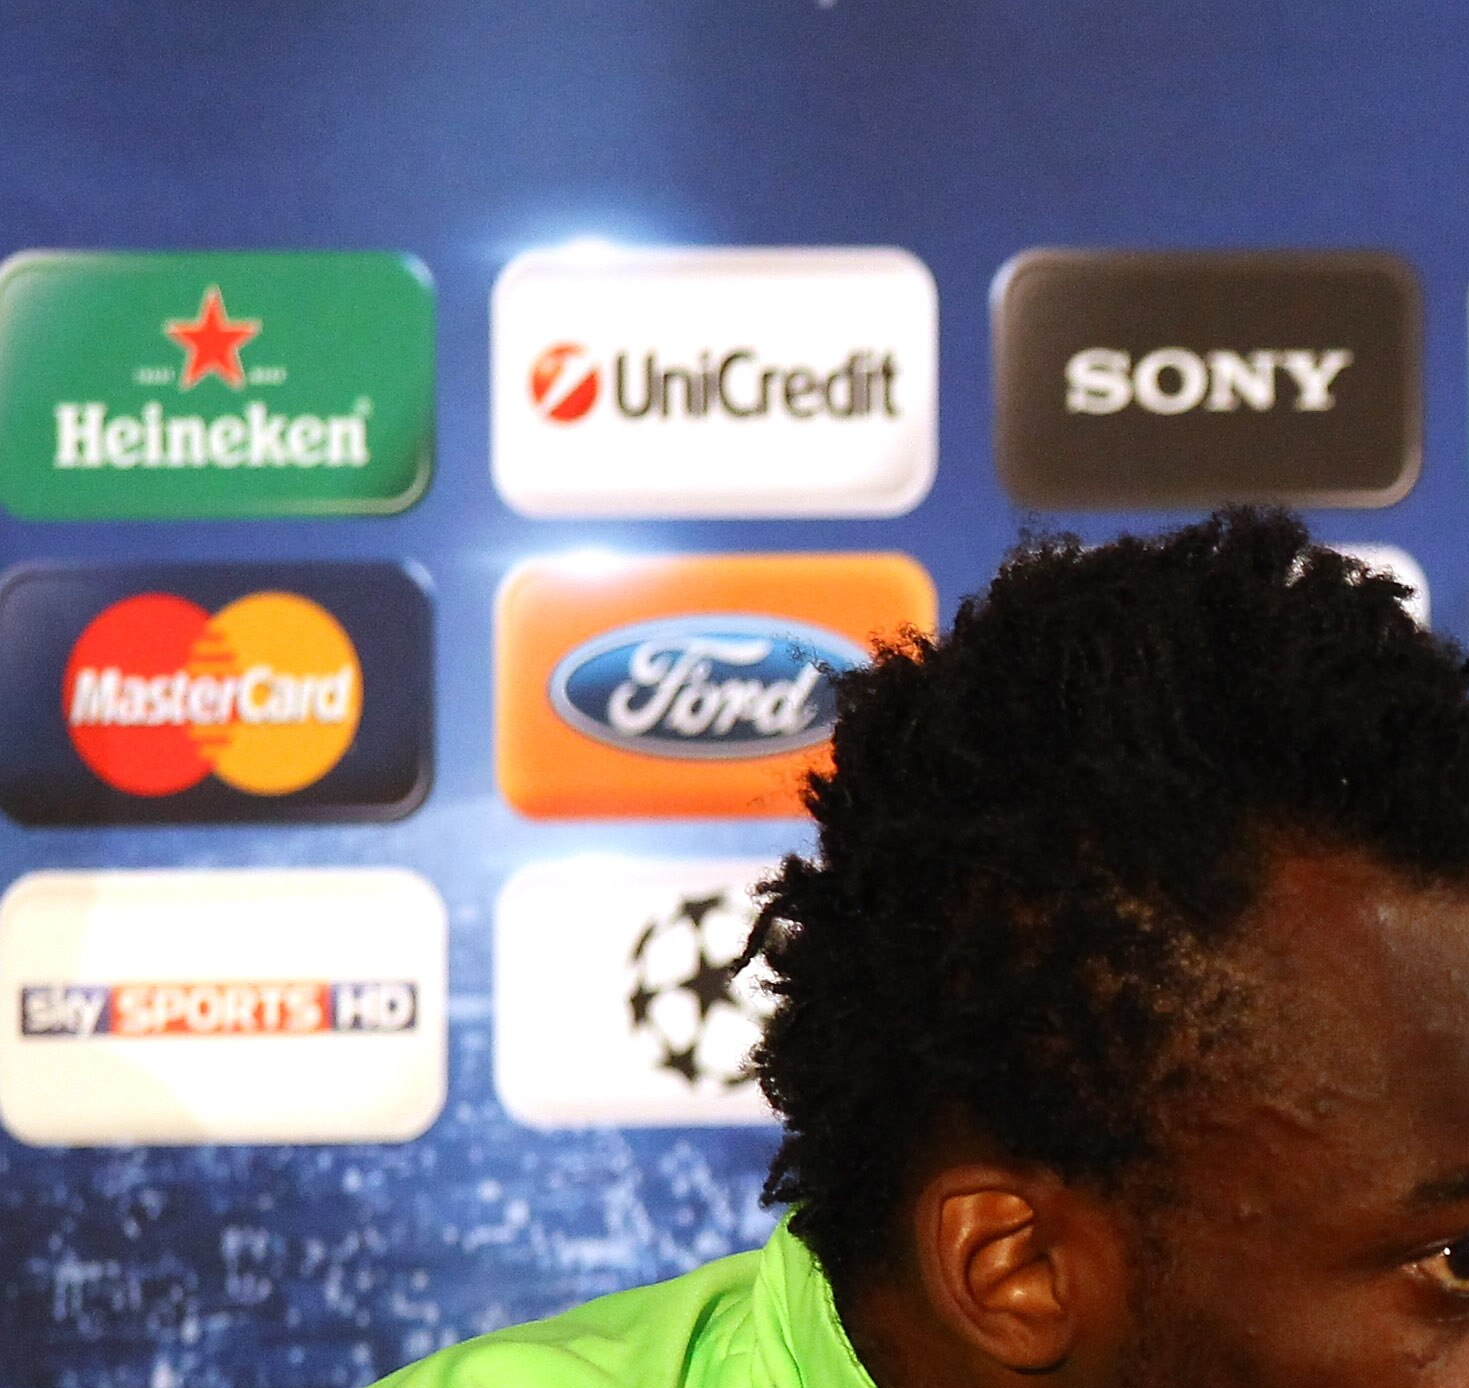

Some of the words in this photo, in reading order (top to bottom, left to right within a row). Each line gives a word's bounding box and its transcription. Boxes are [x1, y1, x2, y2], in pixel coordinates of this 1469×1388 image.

[613, 348, 900, 420] UniCredit
[1065, 346, 1352, 415] SONY
[54, 400, 370, 470] Heineken
[72, 666, 352, 728] MasterCard
[607, 636, 822, 736] Ford
[112, 982, 323, 1034] SPORTS
[334, 982, 416, 1032] HD
